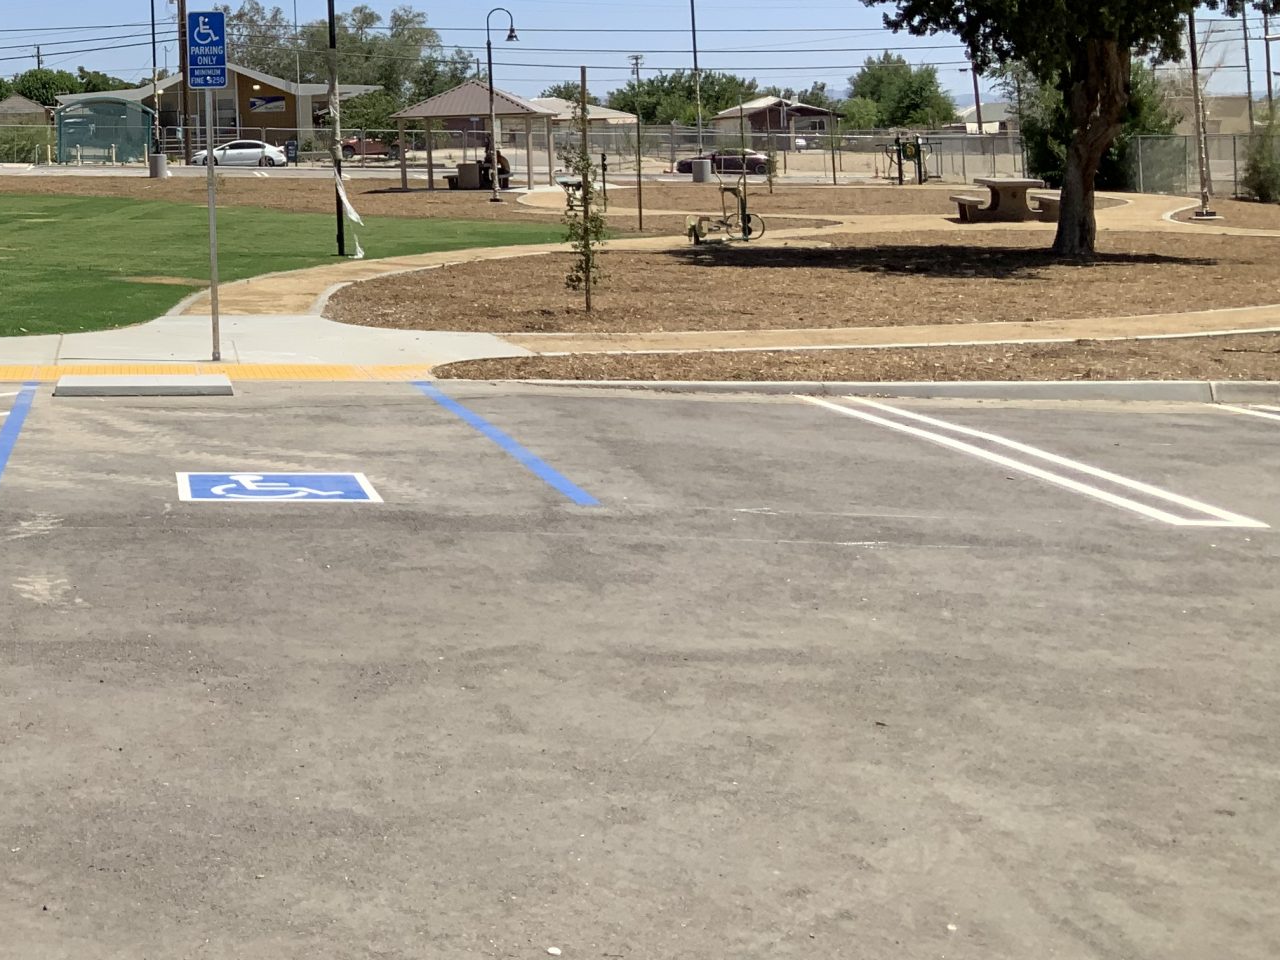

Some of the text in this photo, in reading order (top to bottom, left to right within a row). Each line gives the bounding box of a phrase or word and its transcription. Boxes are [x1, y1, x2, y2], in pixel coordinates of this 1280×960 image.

[190, 46, 224, 55] PARKING
[197, 56, 217, 65] ONLY
[194, 68, 221, 76] MINIMUM
[191, 76, 205, 84] FINE
